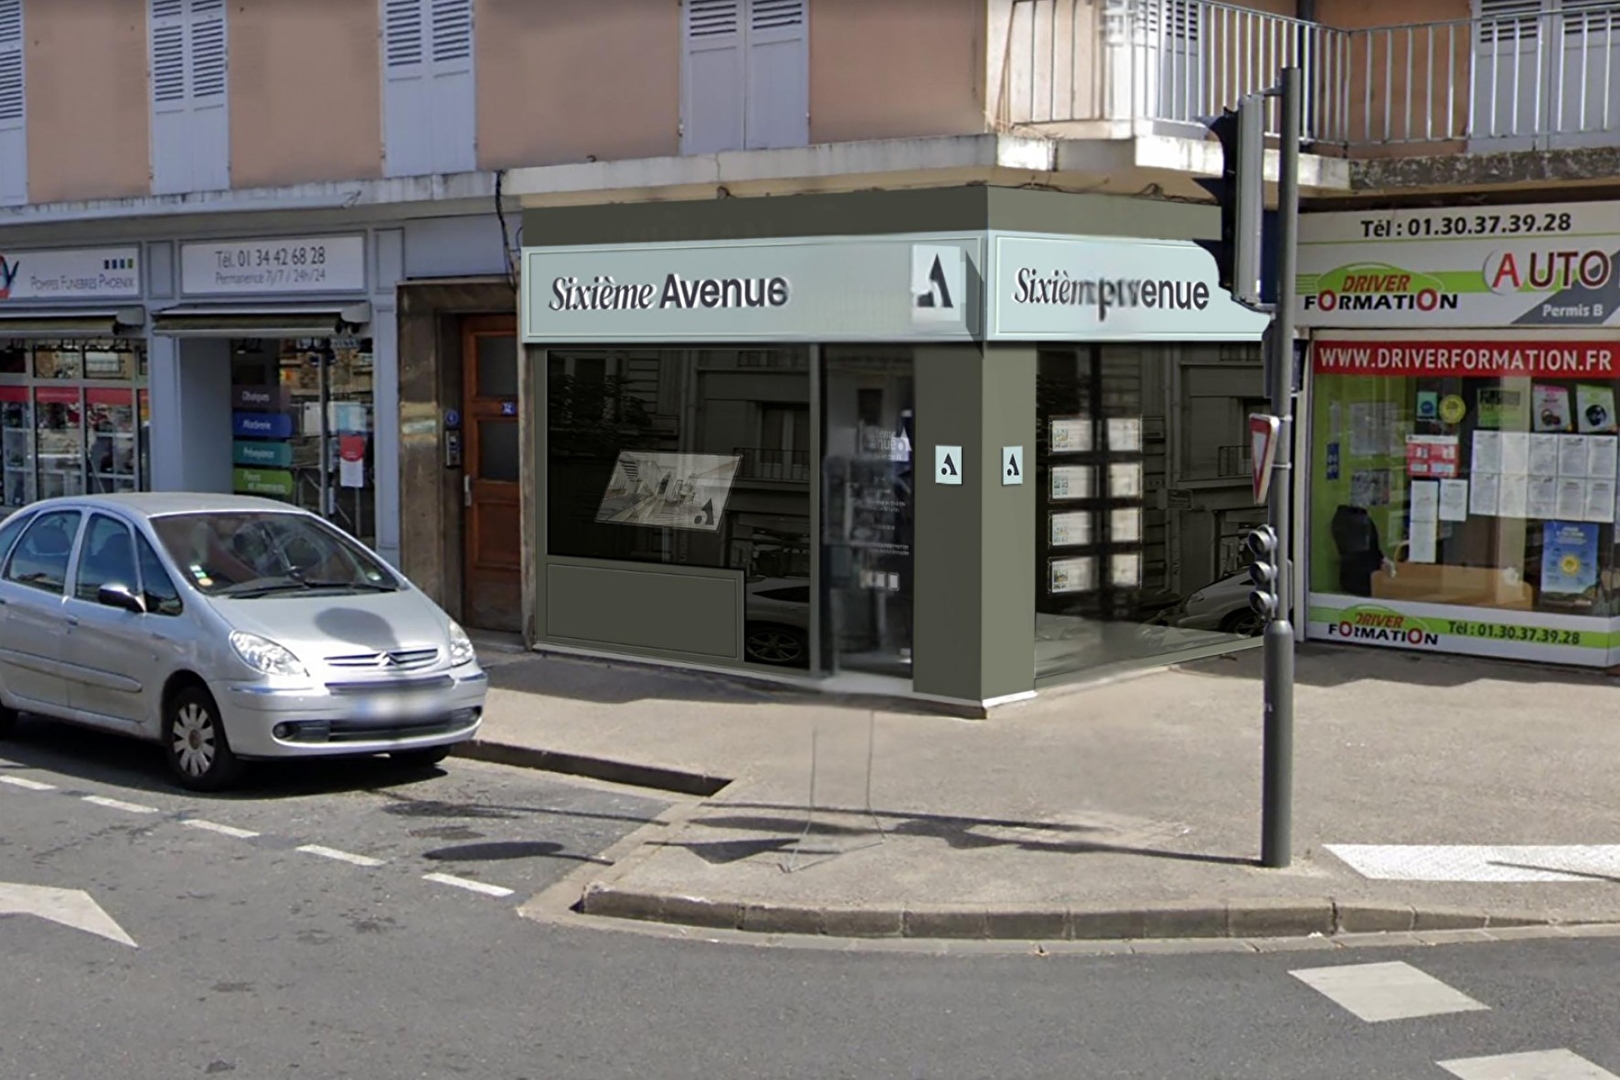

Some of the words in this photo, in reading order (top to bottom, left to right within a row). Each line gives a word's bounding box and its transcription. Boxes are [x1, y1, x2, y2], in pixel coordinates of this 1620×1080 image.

[1408, 213, 1571, 235] 01.30.37.39.28
[238, 249, 251, 267] 01
[256, 249, 270, 266] 34
[274, 248, 288, 265] 42
[292, 247, 307, 265] 68
[310, 246, 325, 264] 28
[1491, 249, 1611, 289] AUTO
[549, 275, 655, 311] Sixième
[659, 273, 789, 308] Avenue
[1342, 274, 1411, 293] DRIVER
[1304, 288, 1458, 311] FORMATION
[1543, 303, 1590, 317] Permis
[1593, 303, 1604, 317] B
[1320, 347, 1612, 370] WWW.DRIVERFORMATION.FR
[1478, 623, 1580, 645] 01.30.37.39.28
